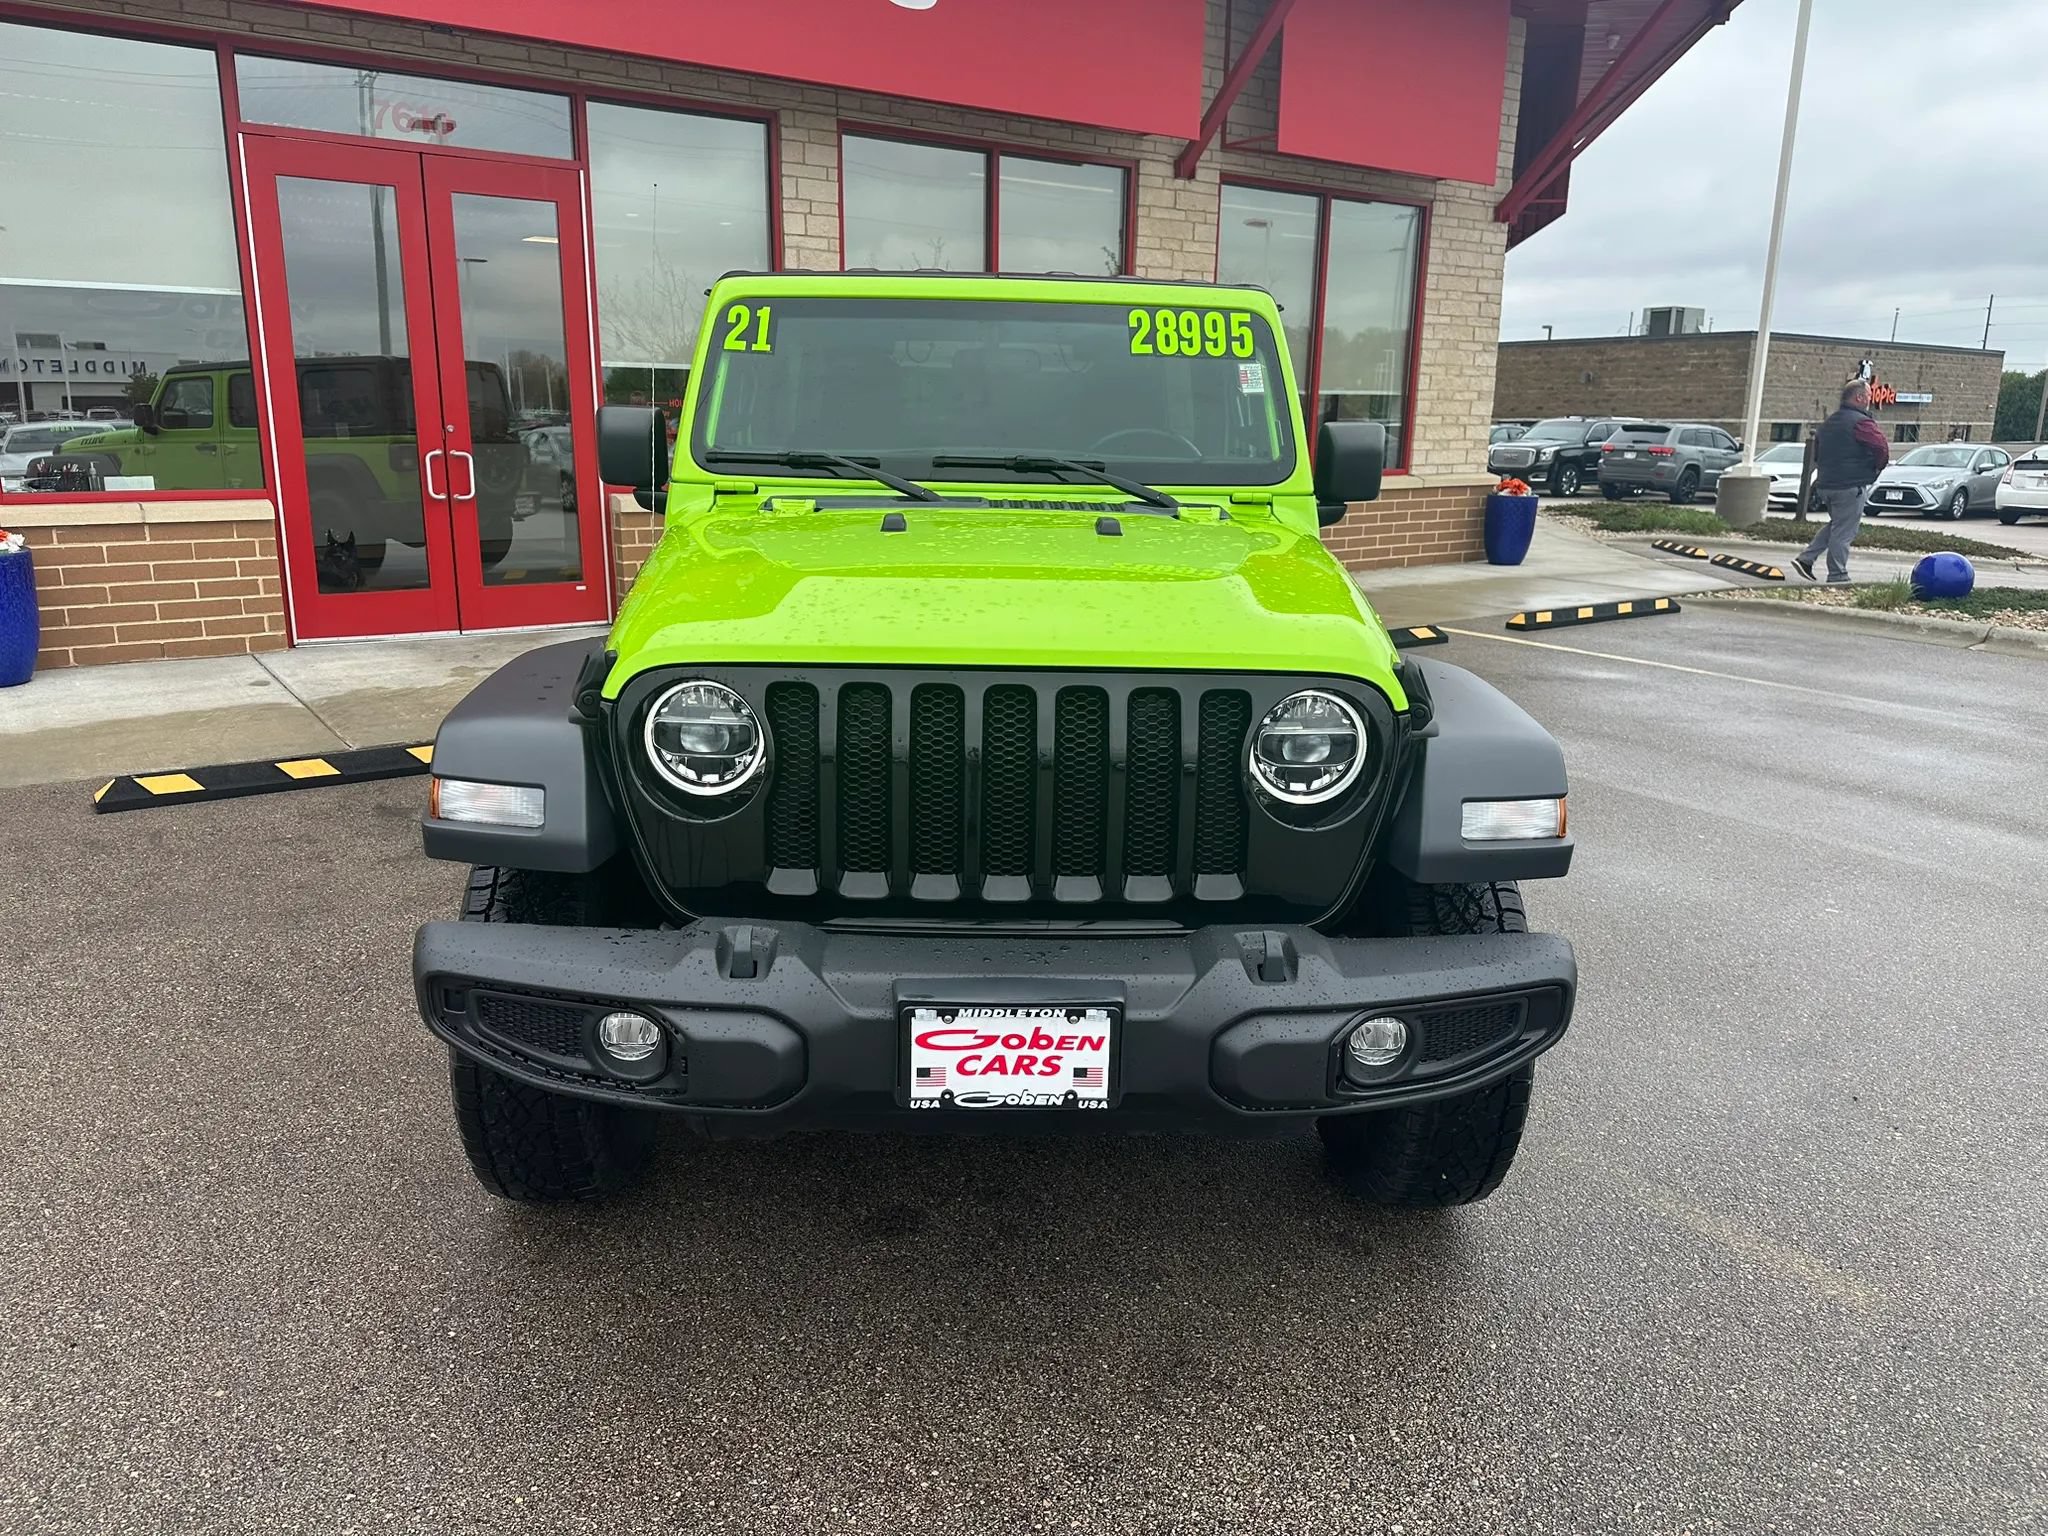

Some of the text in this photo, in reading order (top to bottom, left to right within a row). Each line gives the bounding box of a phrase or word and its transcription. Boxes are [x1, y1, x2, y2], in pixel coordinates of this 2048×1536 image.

[723, 304, 771, 352] 21
[1128, 309, 1254, 358] 28995
[957, 1008, 1067, 1018] MIDDLETON
[955, 1054, 1064, 1076] CARS
[909, 1099, 941, 1109] USA
[1078, 1099, 1109, 1109] USA
